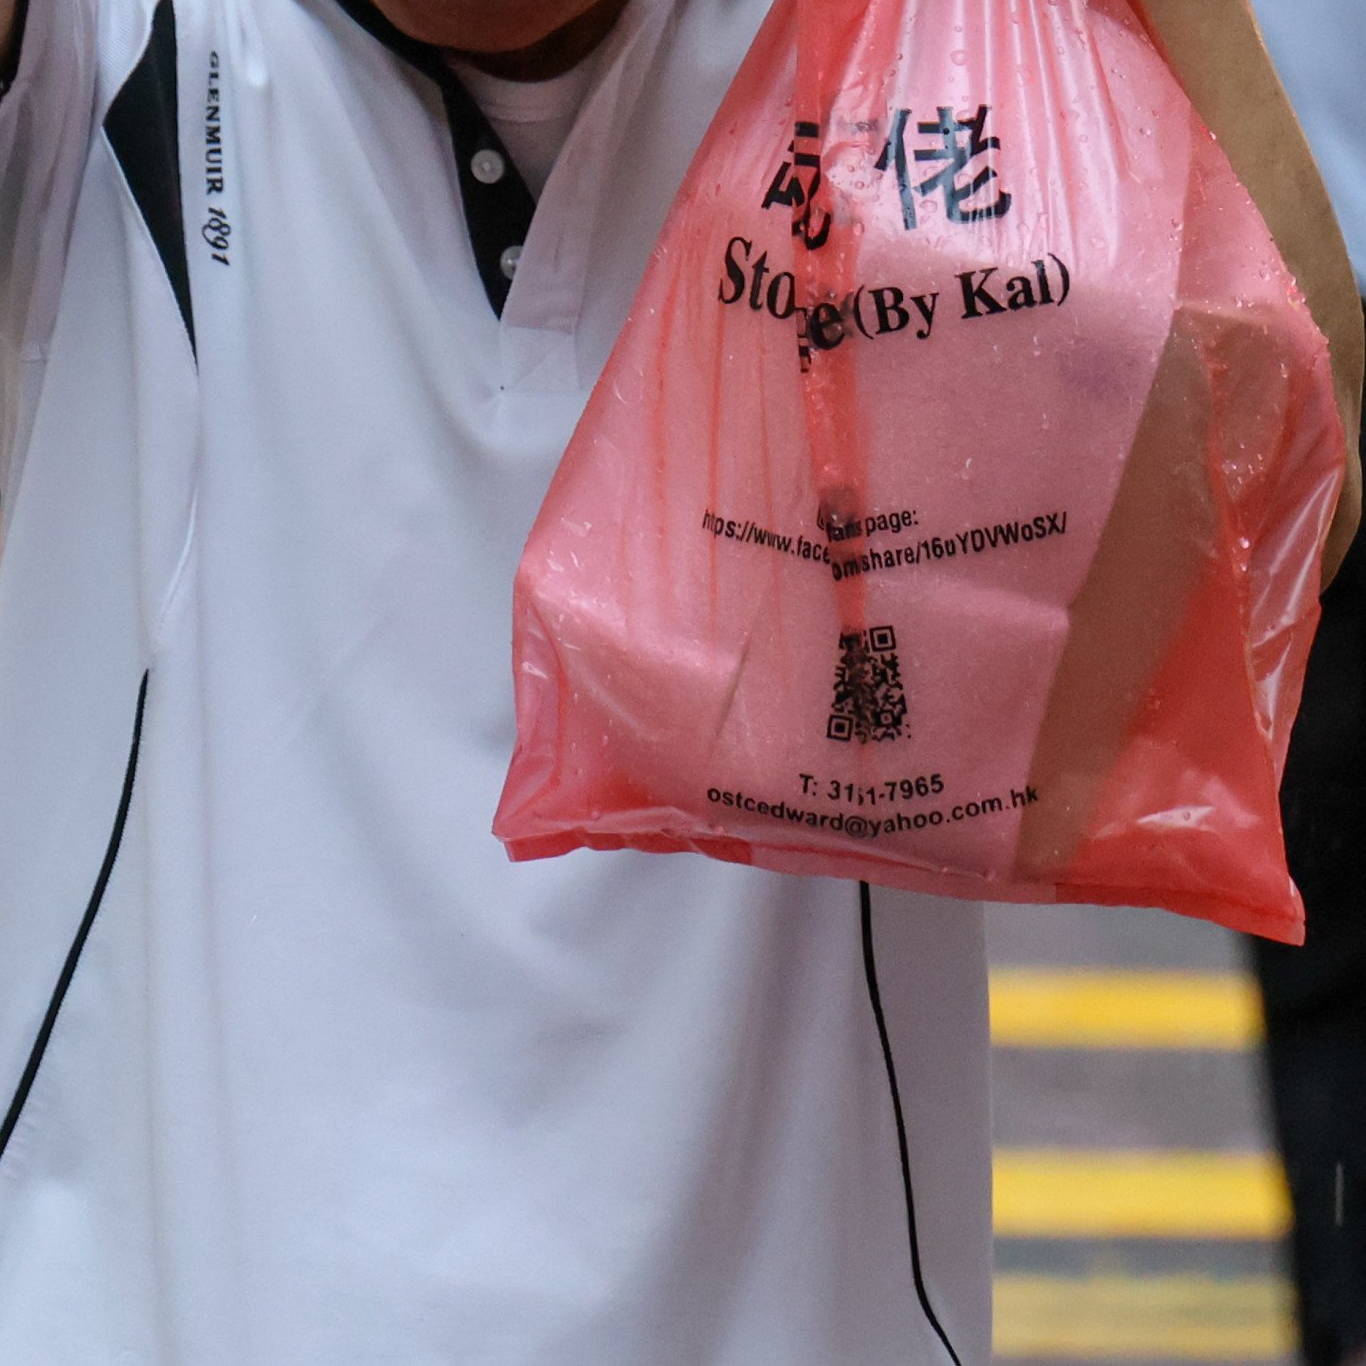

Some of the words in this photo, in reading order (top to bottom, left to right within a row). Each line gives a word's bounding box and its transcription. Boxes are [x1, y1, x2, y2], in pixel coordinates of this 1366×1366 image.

[205, 50, 224, 195] GLENMUIR
[201, 206, 231, 266] 1891
[954, 252, 1070, 319] Kal)
[865, 510, 919, 537] page:
[706, 785, 1039, 839] ostcedward@yahoo.com.hk
[798, 772, 819, 797] T:
